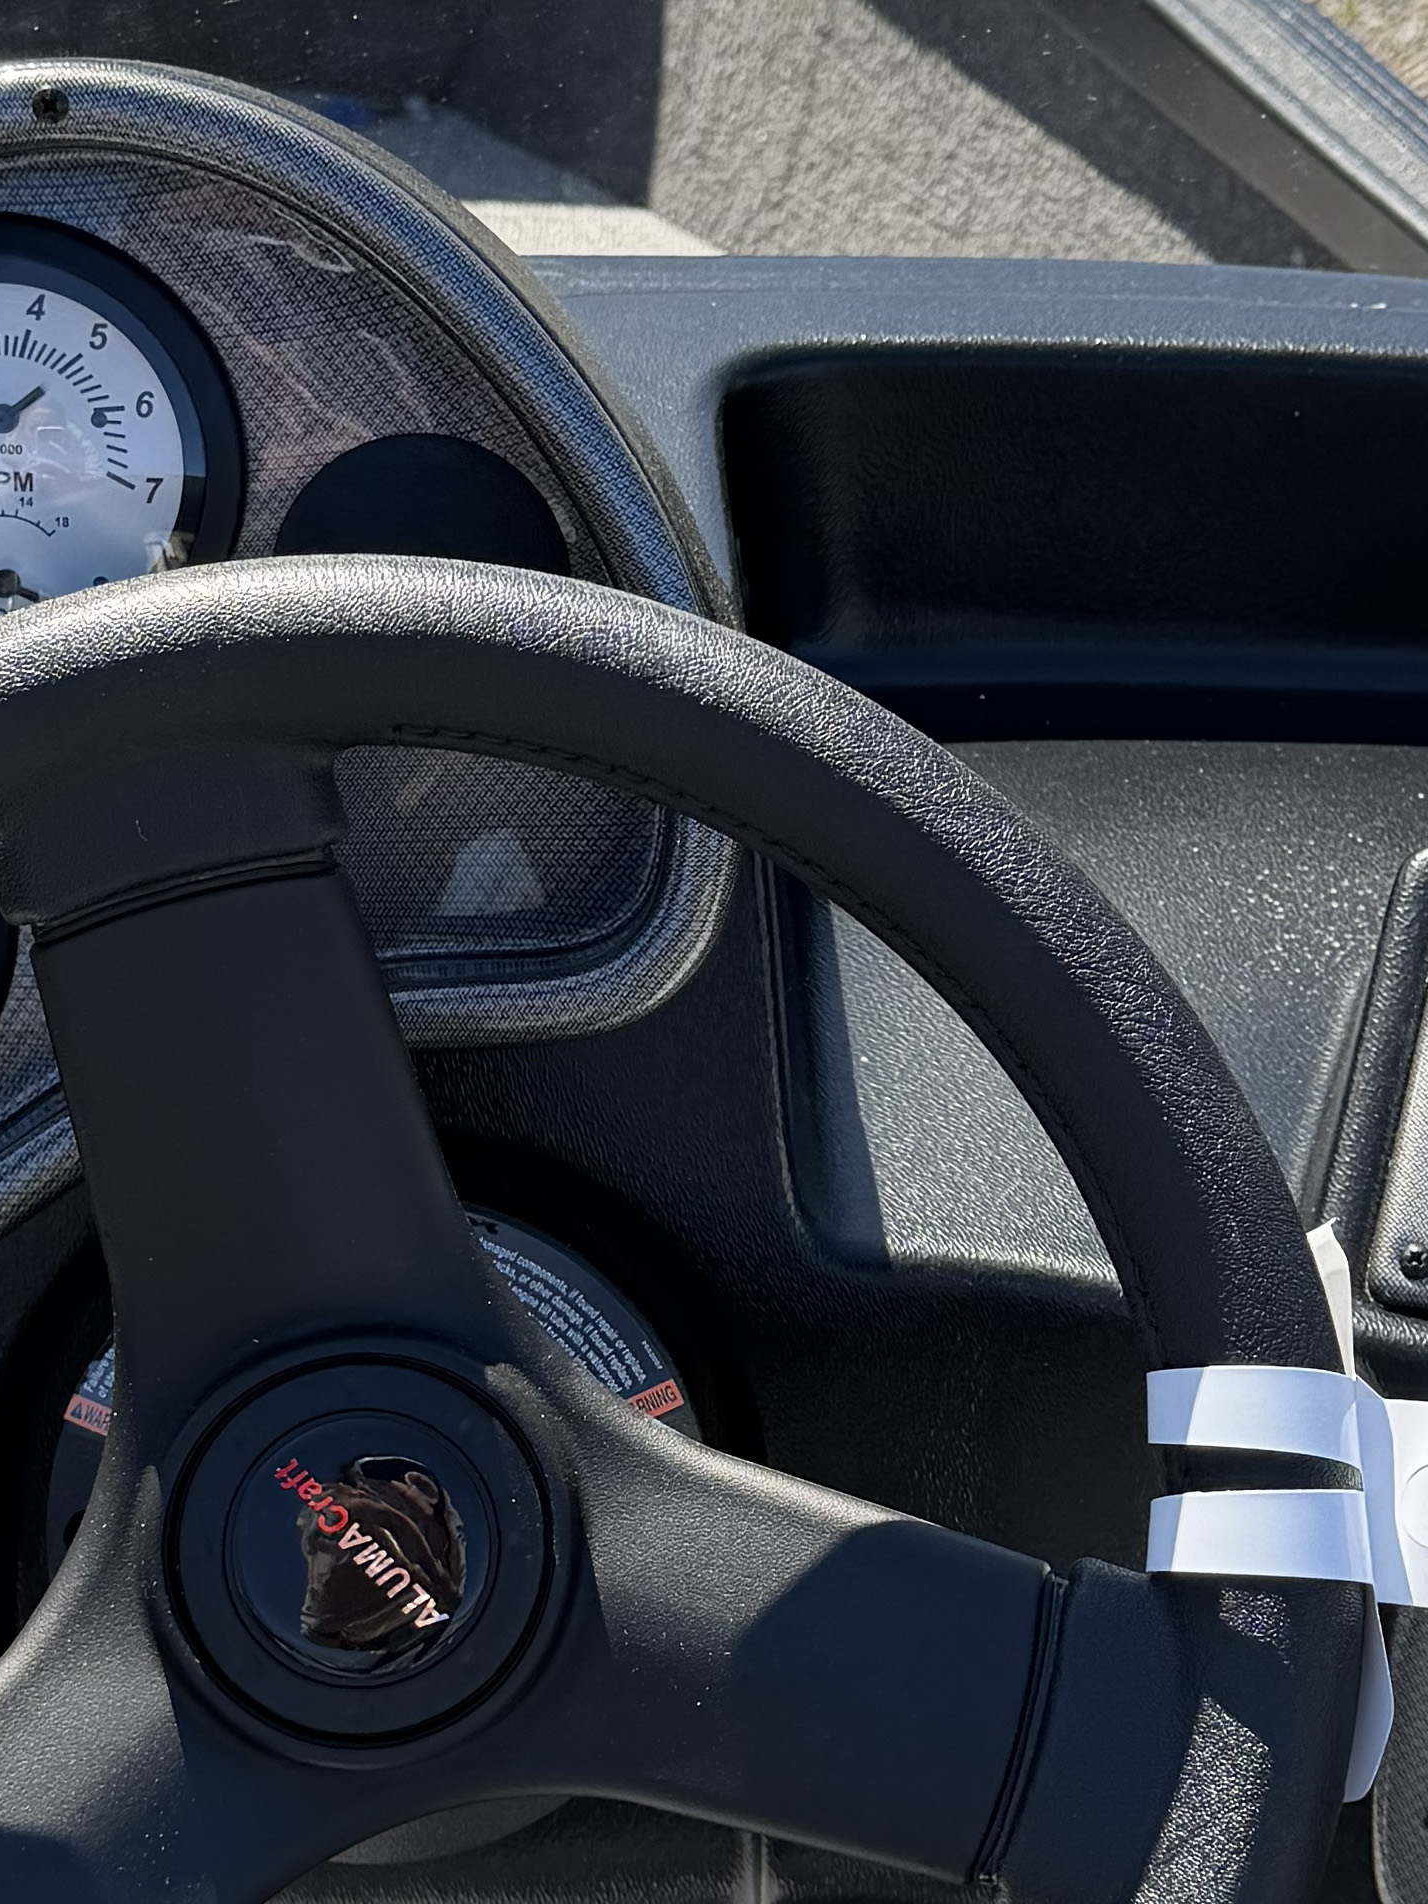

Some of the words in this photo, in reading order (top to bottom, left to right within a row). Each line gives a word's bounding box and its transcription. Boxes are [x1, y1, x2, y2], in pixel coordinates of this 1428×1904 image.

[26, 294, 46, 321] 4
[89, 322, 109, 350] 5
[135, 390, 154, 418] 6
[19, 496, 34, 508] 14
[145, 476, 164, 504] 7
[518, 1274, 531, 1284] or
[529, 1280, 553, 1299] other
[589, 1329, 614, 1357] found
[549, 1311, 569, 1332] tube
[566, 1327, 584, 1347] with
[575, 1295, 601, 1319] found
[595, 1316, 619, 1340] repair
[615, 1339, 627, 1350] or
[636, 1384, 678, 1411] RNING
[273, 1457, 450, 1629] ALUMACraft
